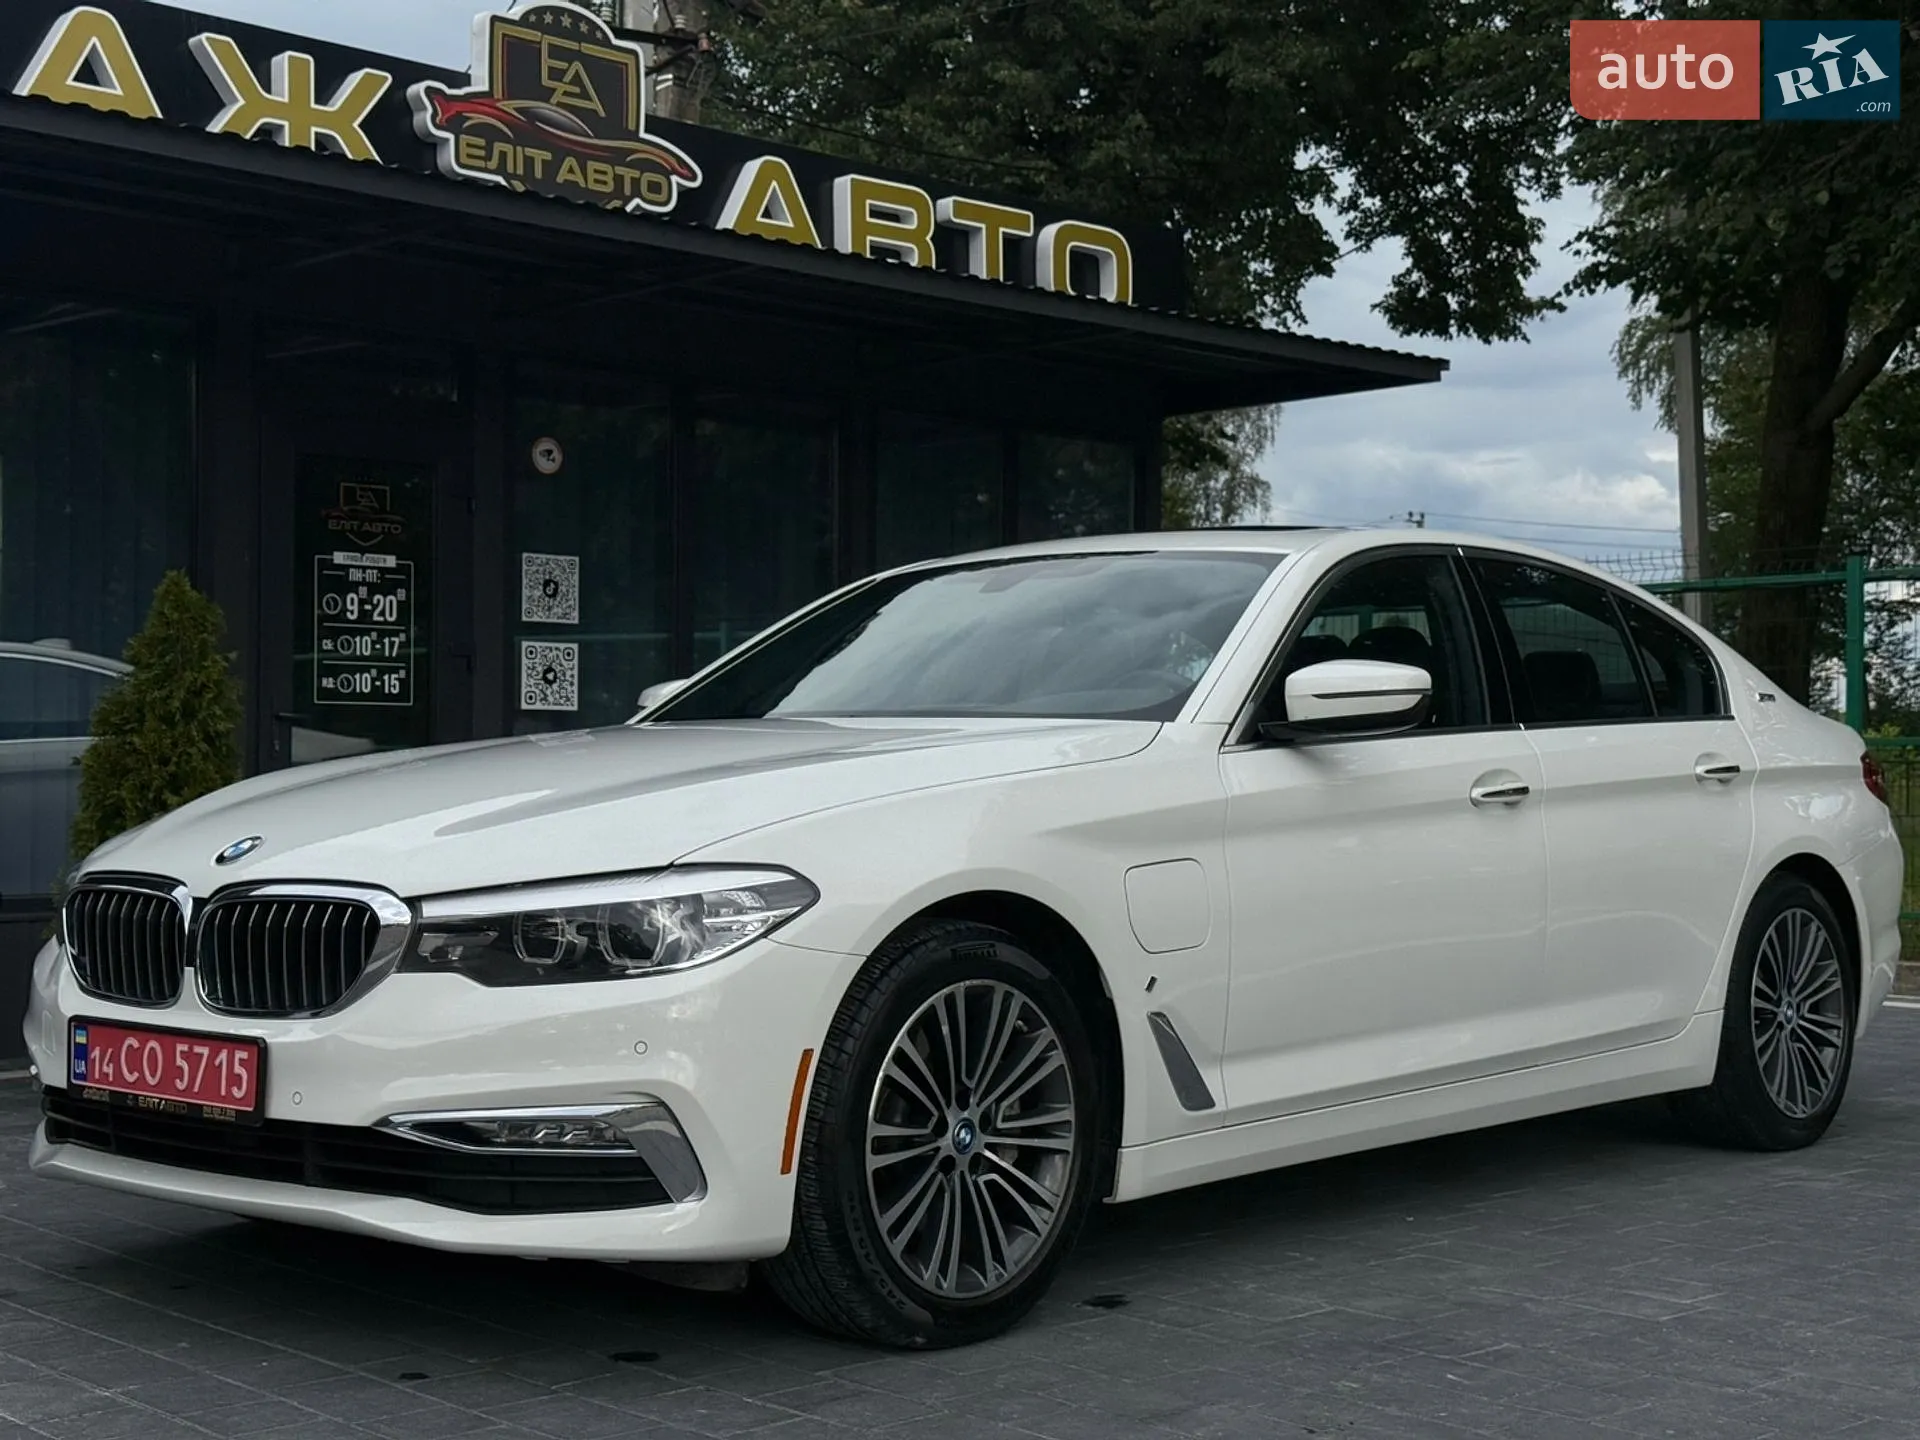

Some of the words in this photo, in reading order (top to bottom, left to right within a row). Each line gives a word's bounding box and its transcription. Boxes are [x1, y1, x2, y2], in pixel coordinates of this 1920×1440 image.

[459, 134, 552, 179] ЕЛІТ
[556, 156, 669, 201] АВТО
[715, 155, 1133, 305] АВТО
[74, 1058, 86, 1074] UA
[175, 1043, 249, 1099] 5715
